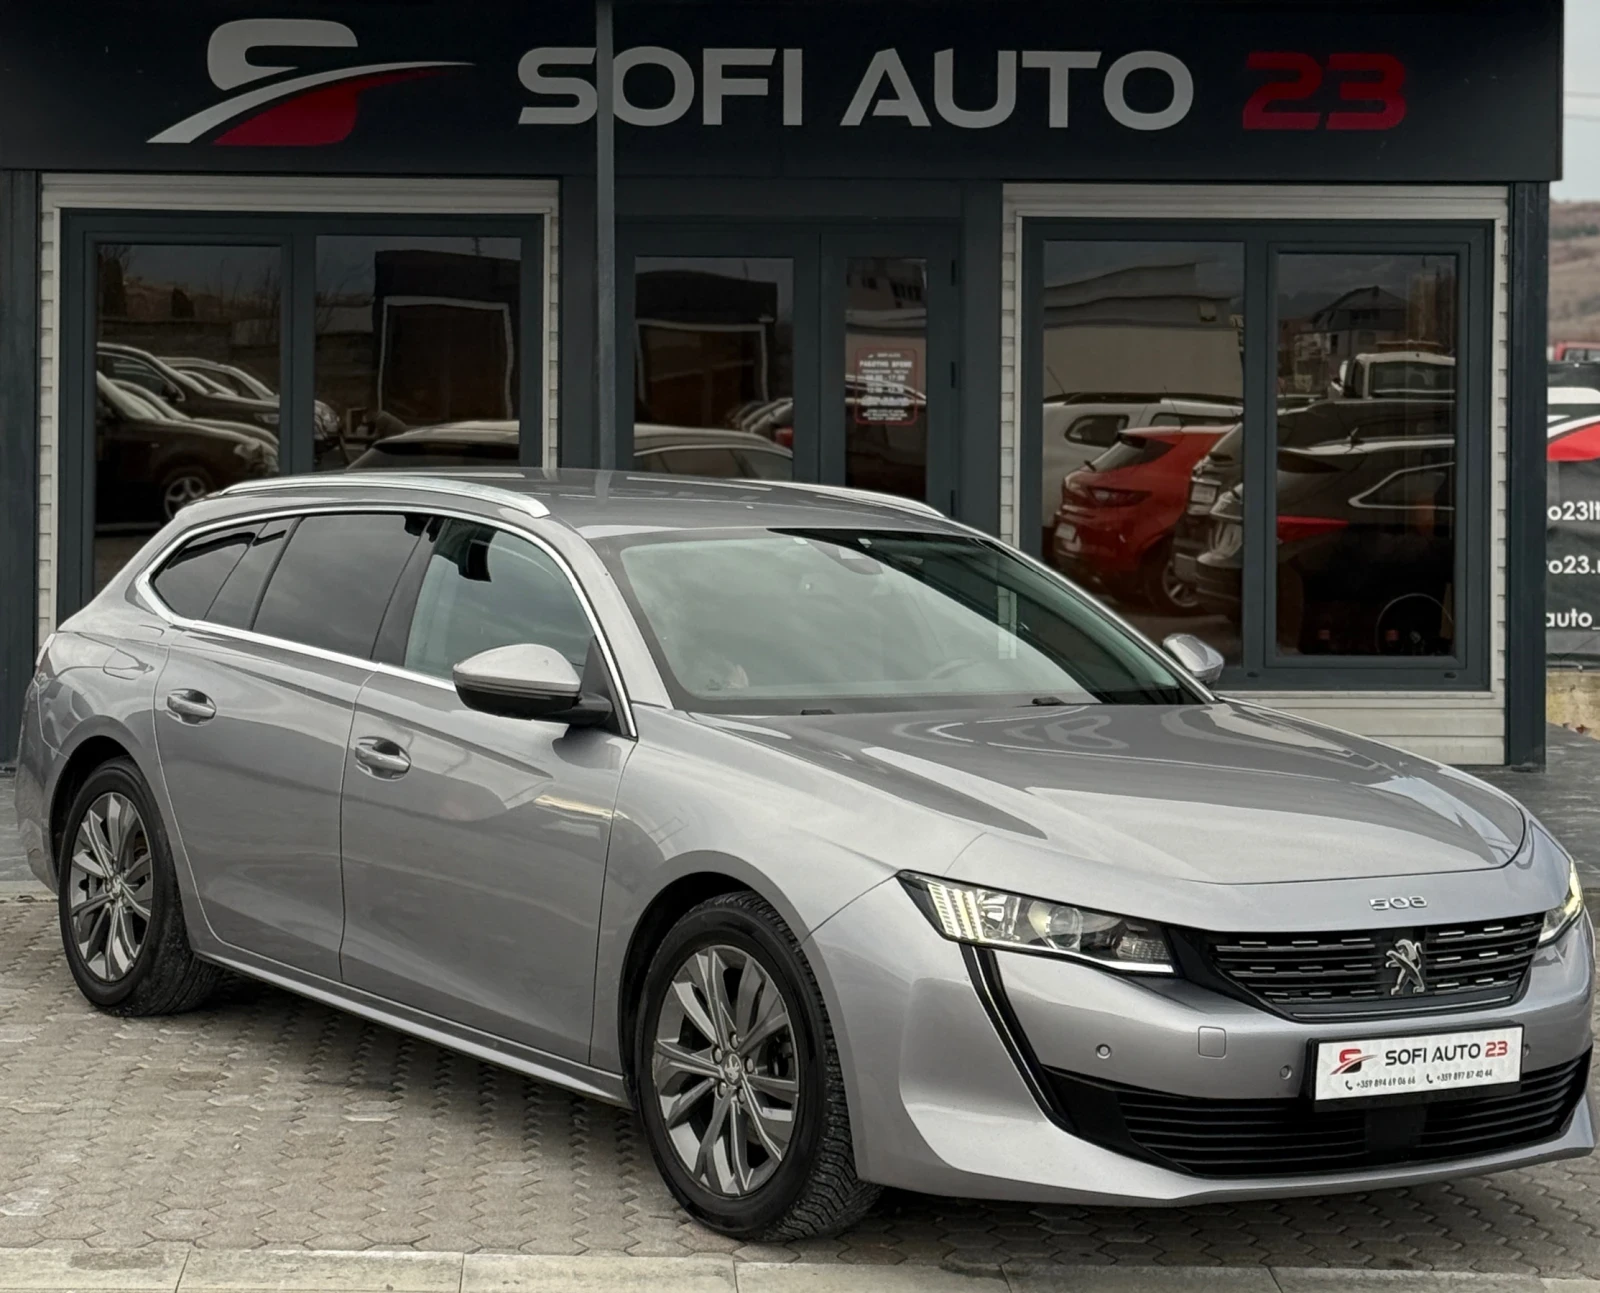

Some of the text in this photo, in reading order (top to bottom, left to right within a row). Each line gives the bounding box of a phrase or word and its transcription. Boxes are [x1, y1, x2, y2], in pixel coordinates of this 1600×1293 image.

[517, 45, 1408, 131] SOFI AUTO 23
[1369, 896, 1427, 910] 508
[1385, 1040, 1508, 1067] SOFI AUTO 23
[1356, 1079, 1373, 1089] +359
[1437, 1072, 1452, 1082] +359
